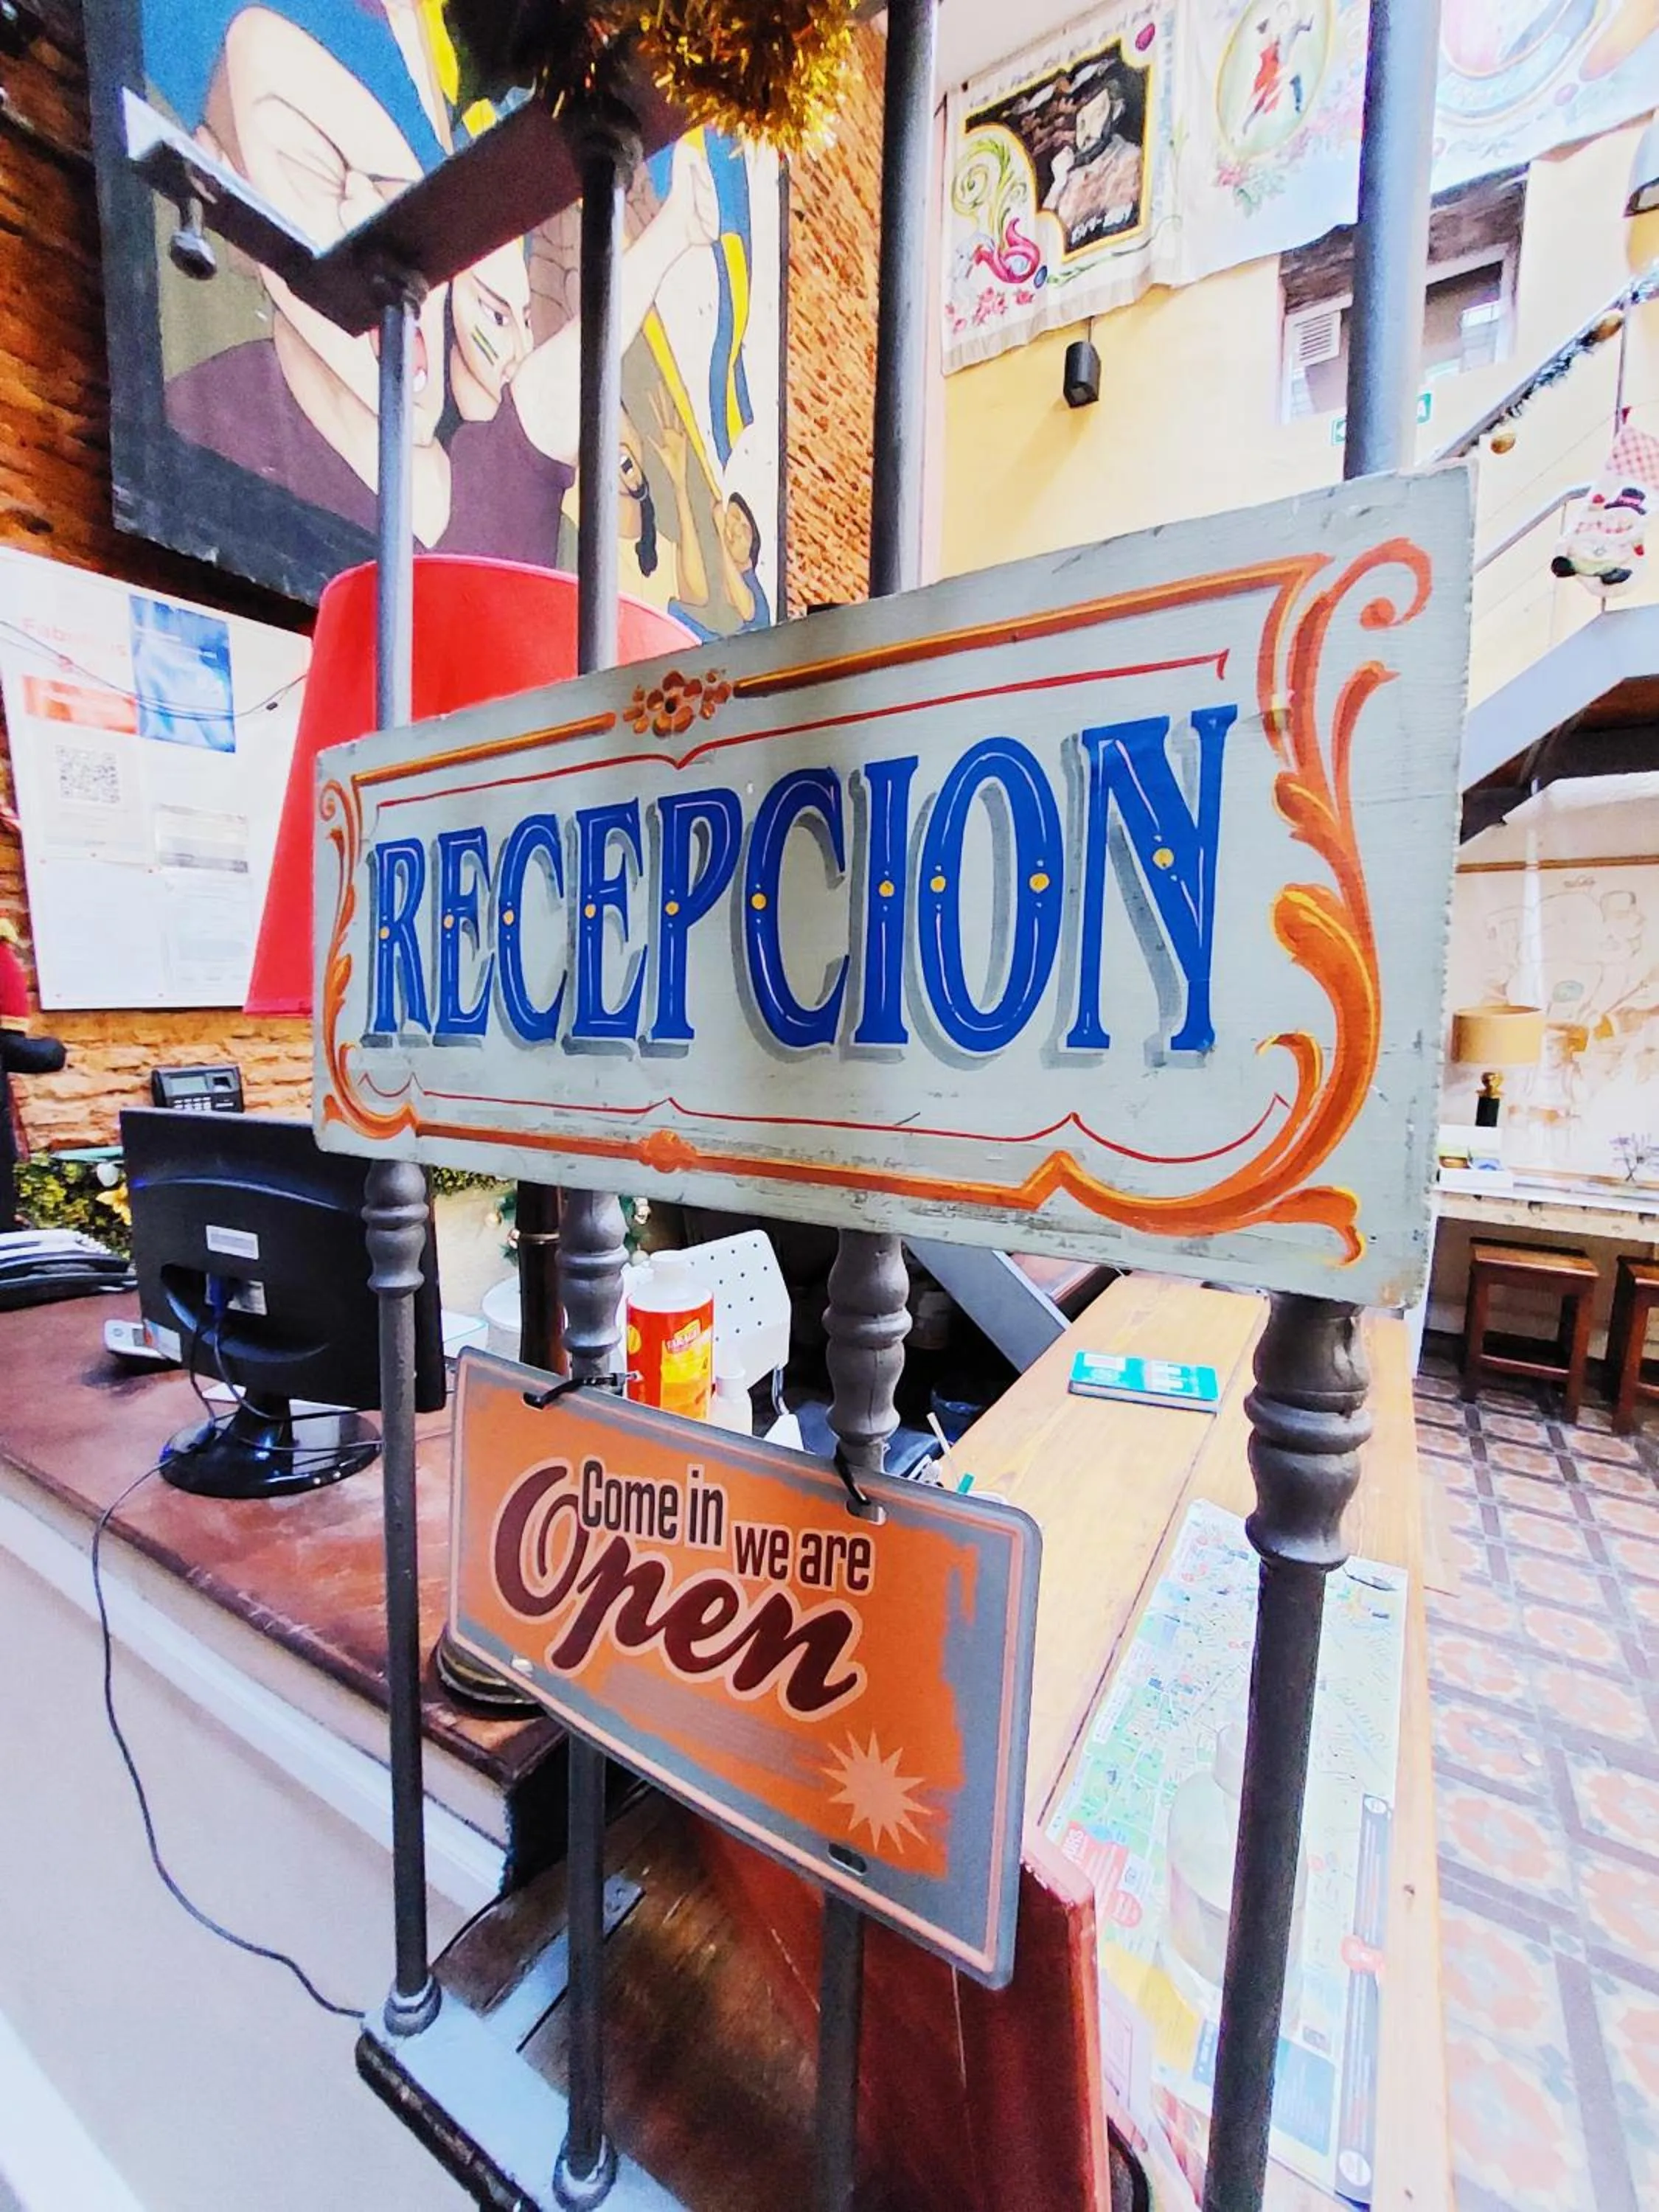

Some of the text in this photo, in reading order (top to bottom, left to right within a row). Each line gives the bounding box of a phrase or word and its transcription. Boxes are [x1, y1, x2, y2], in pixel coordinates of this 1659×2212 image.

[370, 704, 1237, 1054] RECEPCION
[495, 1465, 858, 1712] Open
[581, 1460, 872, 1591] Come in we are
